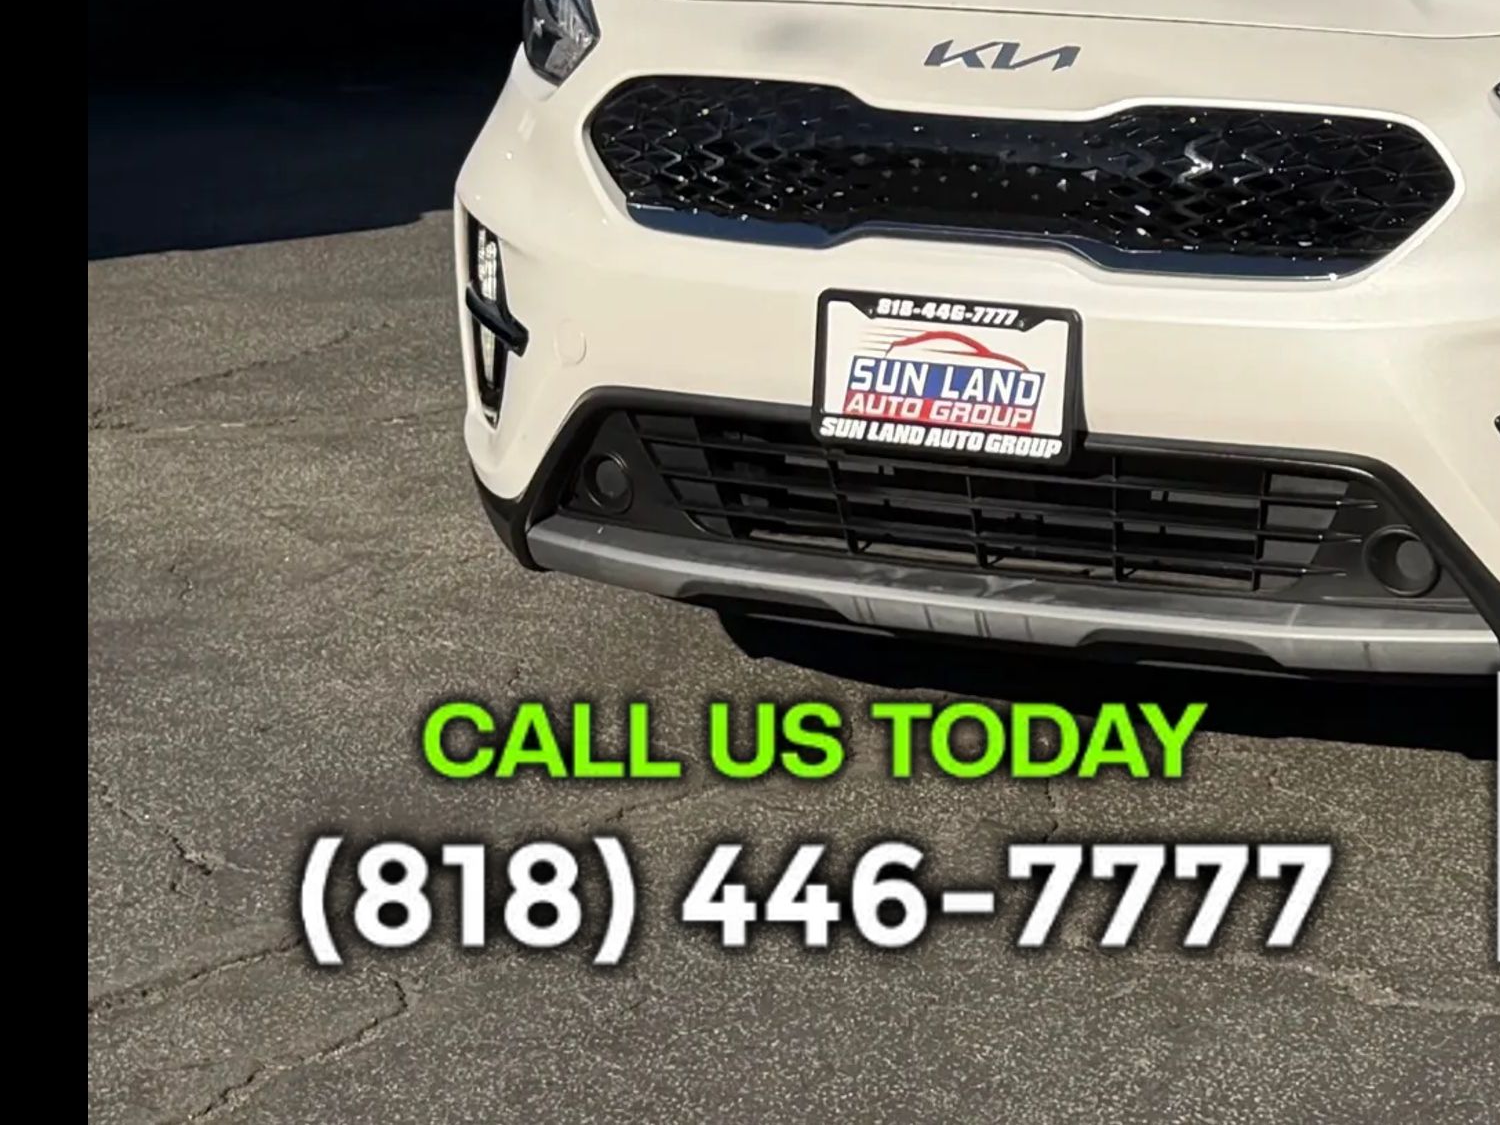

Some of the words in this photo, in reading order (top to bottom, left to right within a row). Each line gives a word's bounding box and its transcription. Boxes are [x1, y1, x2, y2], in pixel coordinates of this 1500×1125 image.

[924, 39, 1081, 71] KIA
[876, 298, 1019, 326] 818-446-7777
[850, 358, 929, 397] SUN
[941, 366, 1041, 407] LAND
[847, 393, 923, 420] AUTO
[929, 399, 1034, 429] GROUP
[820, 417, 866, 440] SUN
[866, 424, 923, 448] LAND
[924, 430, 983, 453] AUTO
[984, 433, 1063, 459] GROUP
